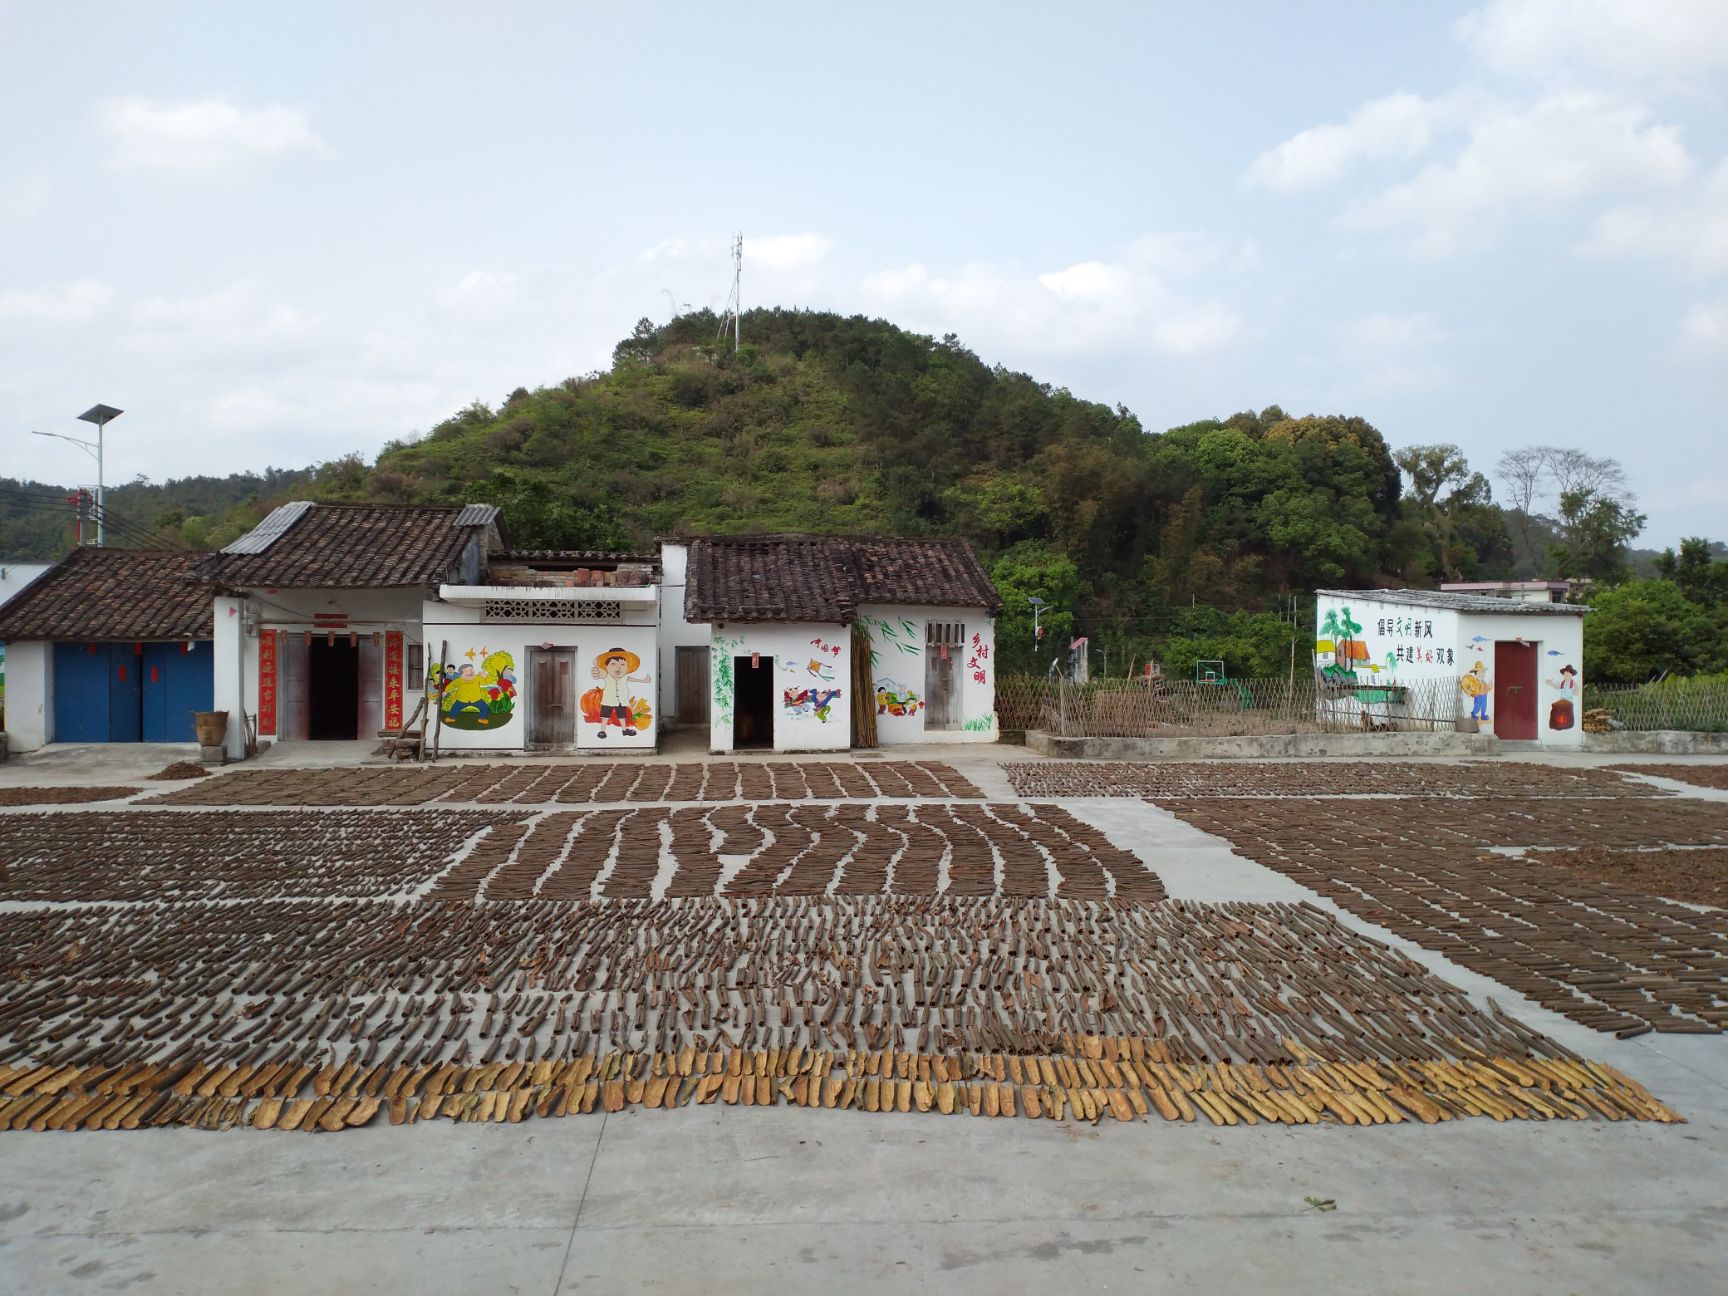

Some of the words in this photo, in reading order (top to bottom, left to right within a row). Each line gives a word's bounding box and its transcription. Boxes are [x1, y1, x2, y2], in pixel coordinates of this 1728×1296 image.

[1377, 617, 1433, 638] 倡导文明新风
[967, 632, 990, 685] 乡村文明
